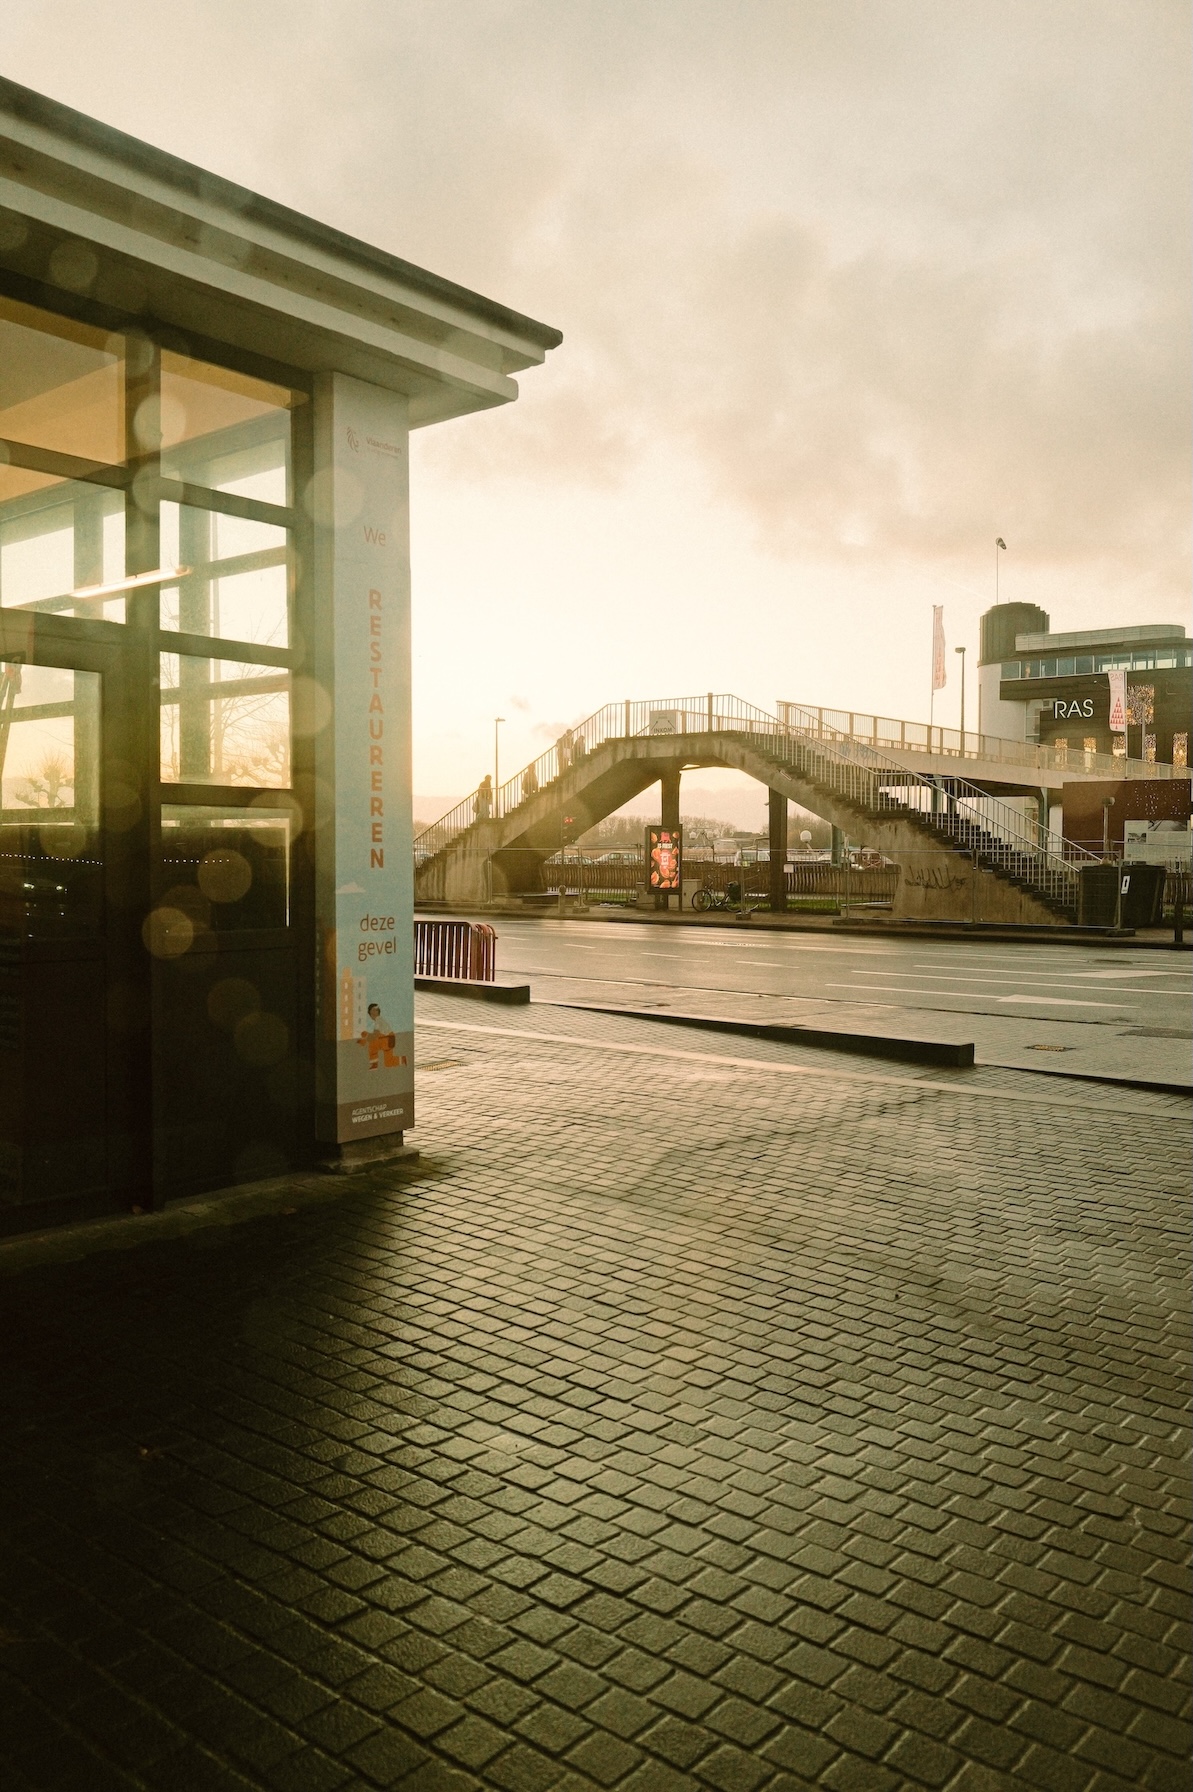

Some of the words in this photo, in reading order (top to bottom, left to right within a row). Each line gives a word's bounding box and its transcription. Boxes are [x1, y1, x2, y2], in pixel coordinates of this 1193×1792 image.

[364, 526, 386, 546] We
[1055, 699, 1094, 719] RAS
[369, 589, 384, 868] RESTAUREREN
[360, 914, 395, 931] deze
[358, 936, 396, 962] gevel
[352, 1103, 387, 1116] AGENTSCHAP
[352, 1113, 373, 1123] WEGEN
[378, 1107, 404, 1119] VERKEER
